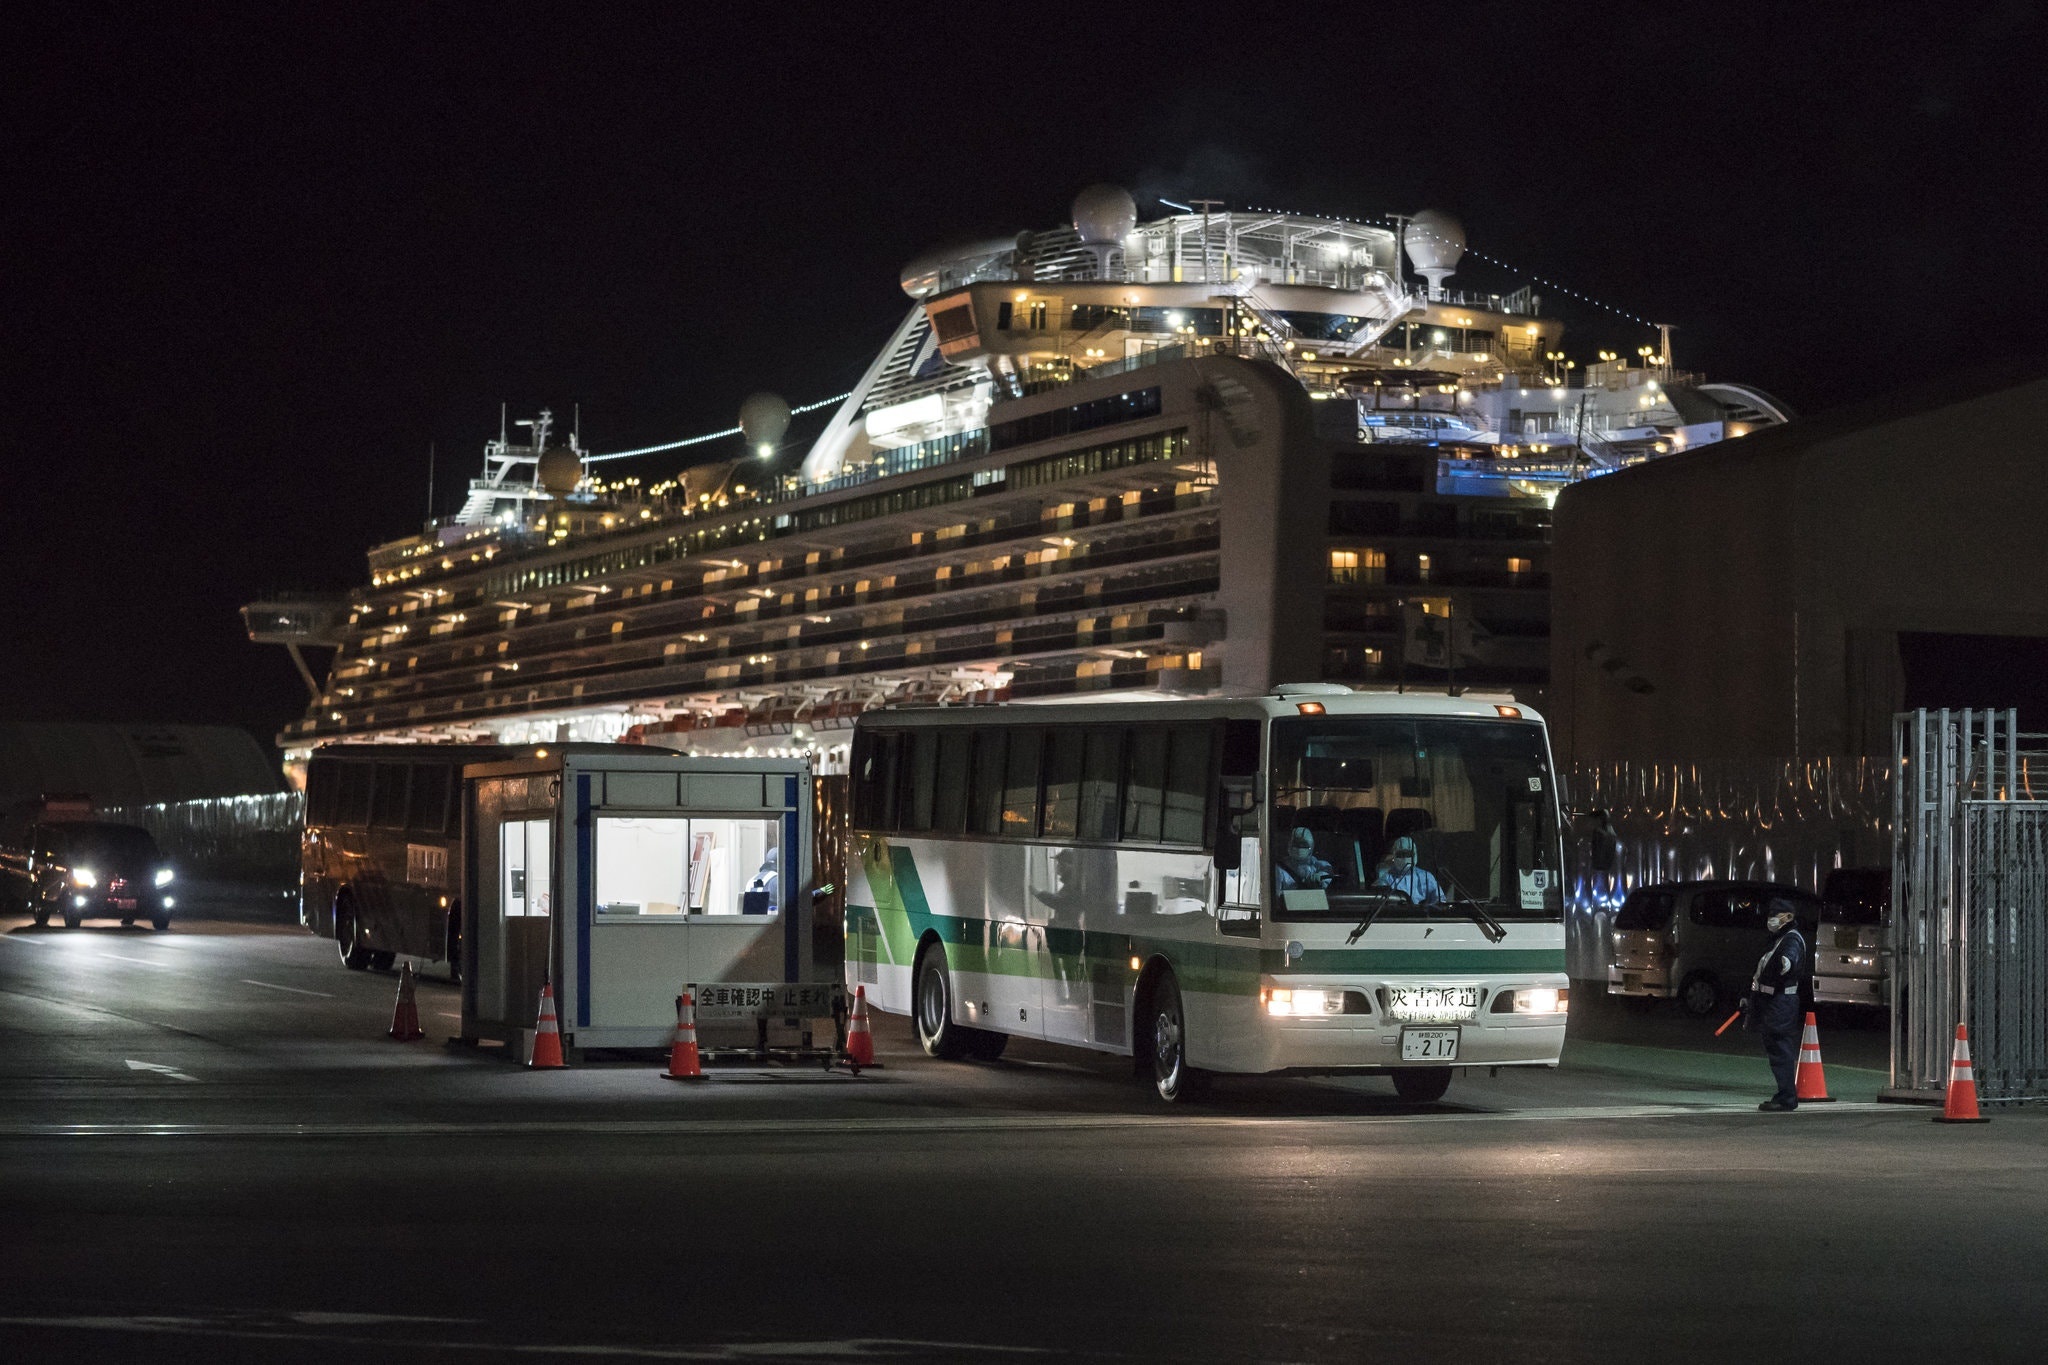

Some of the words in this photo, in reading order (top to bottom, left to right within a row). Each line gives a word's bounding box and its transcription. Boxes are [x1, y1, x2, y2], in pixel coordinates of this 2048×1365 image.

[700, 987, 775, 1007] 全車確認中
[783, 988, 830, 1006] 止まれ
